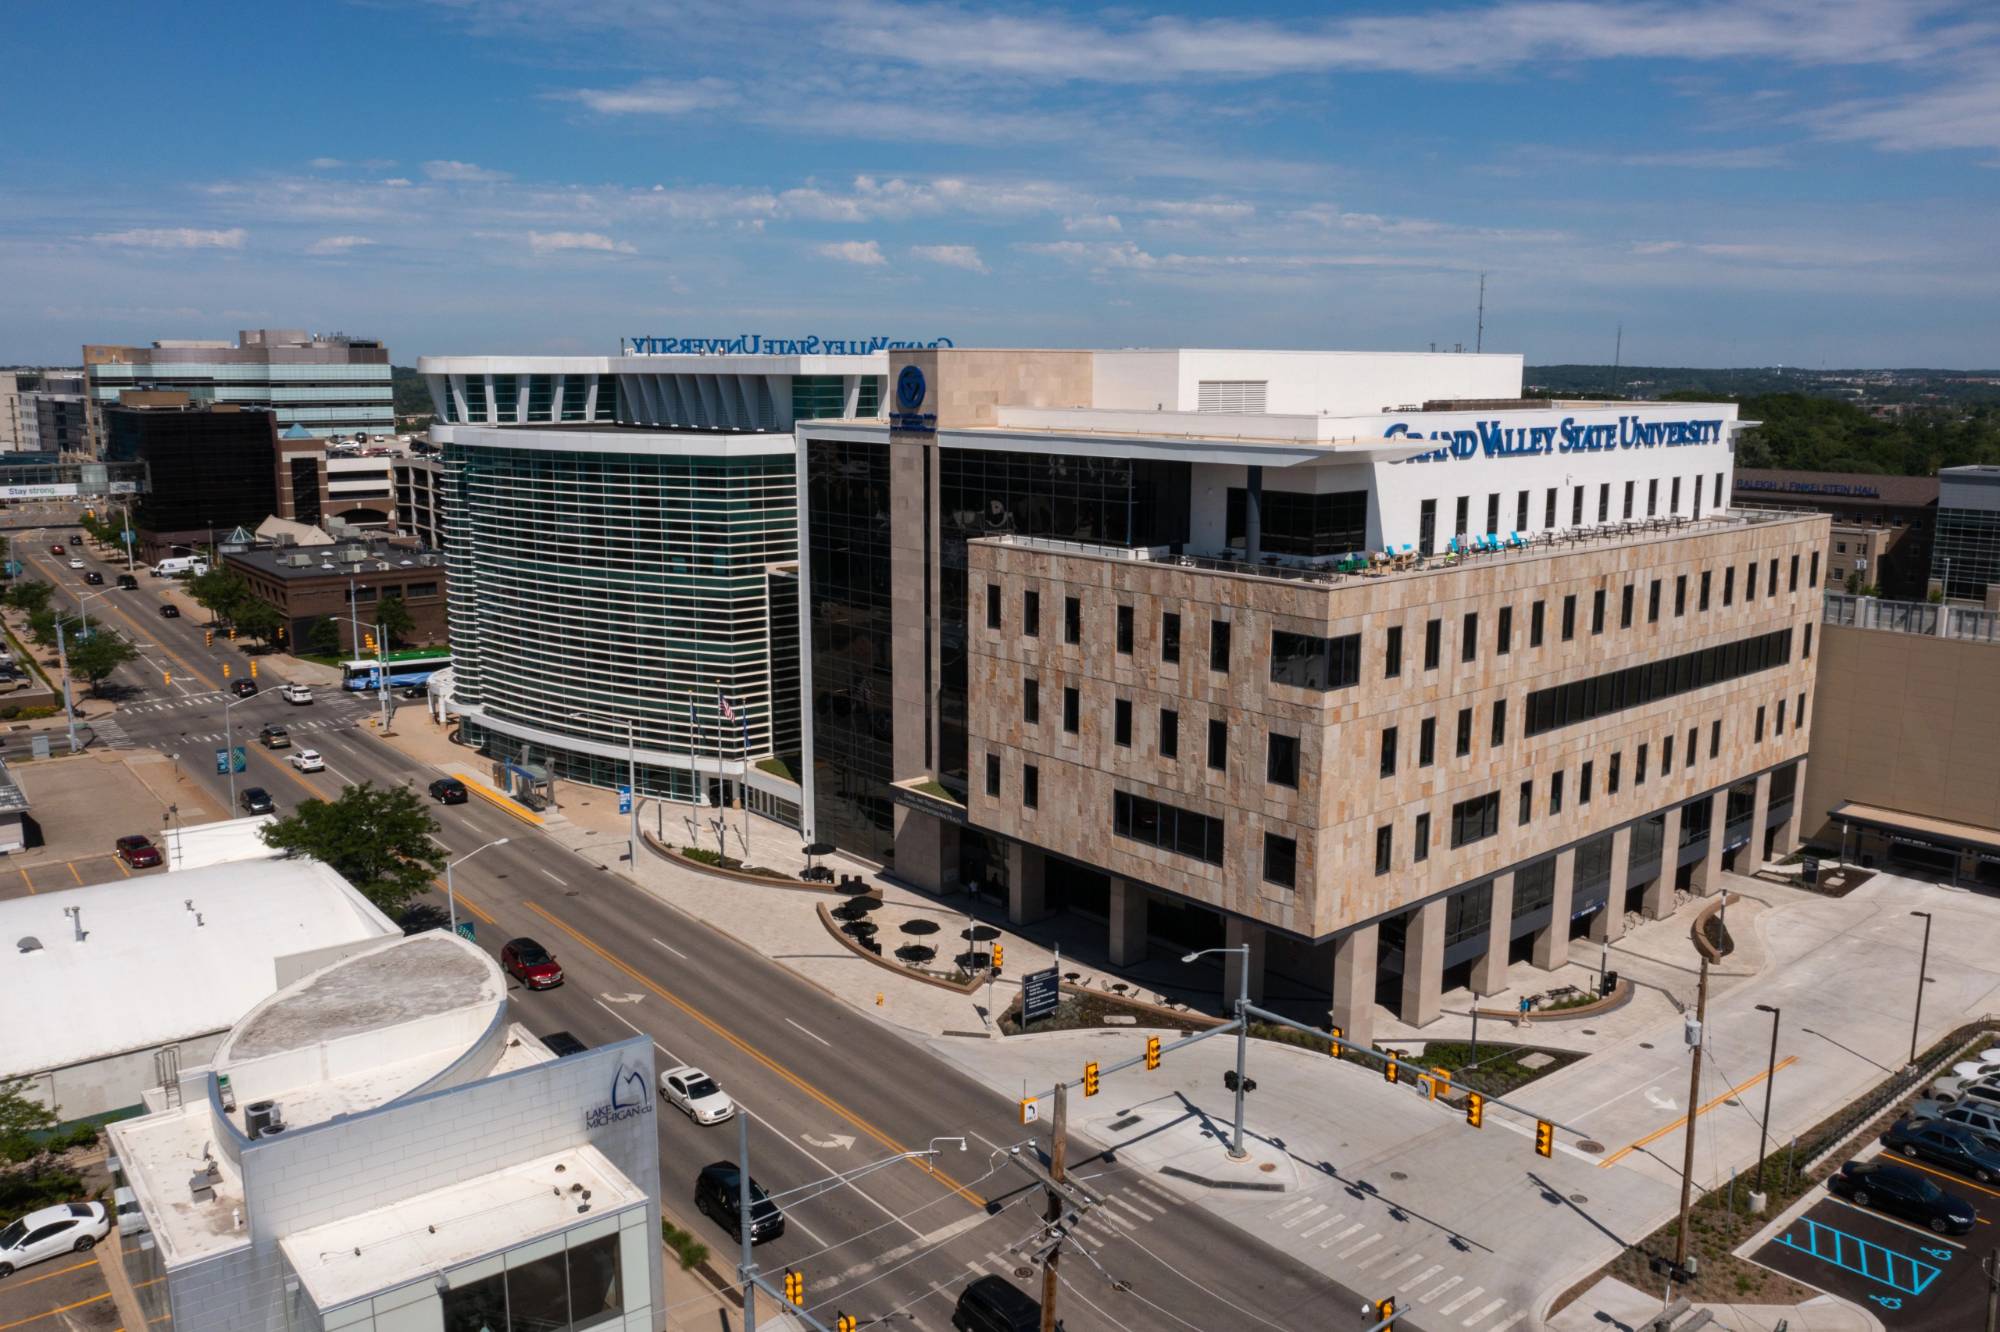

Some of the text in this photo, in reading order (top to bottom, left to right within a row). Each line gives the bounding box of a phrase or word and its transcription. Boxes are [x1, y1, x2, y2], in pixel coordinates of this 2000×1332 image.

[1476, 421, 1558, 459] VALLEY
[1559, 417, 1617, 453] STATE
[1619, 415, 1723, 450] UNIVERSITY
[8, 487, 27, 495] Stay
[586, 1104, 611, 1121] LAKE
[586, 1105, 640, 1131] MICHIGAN
